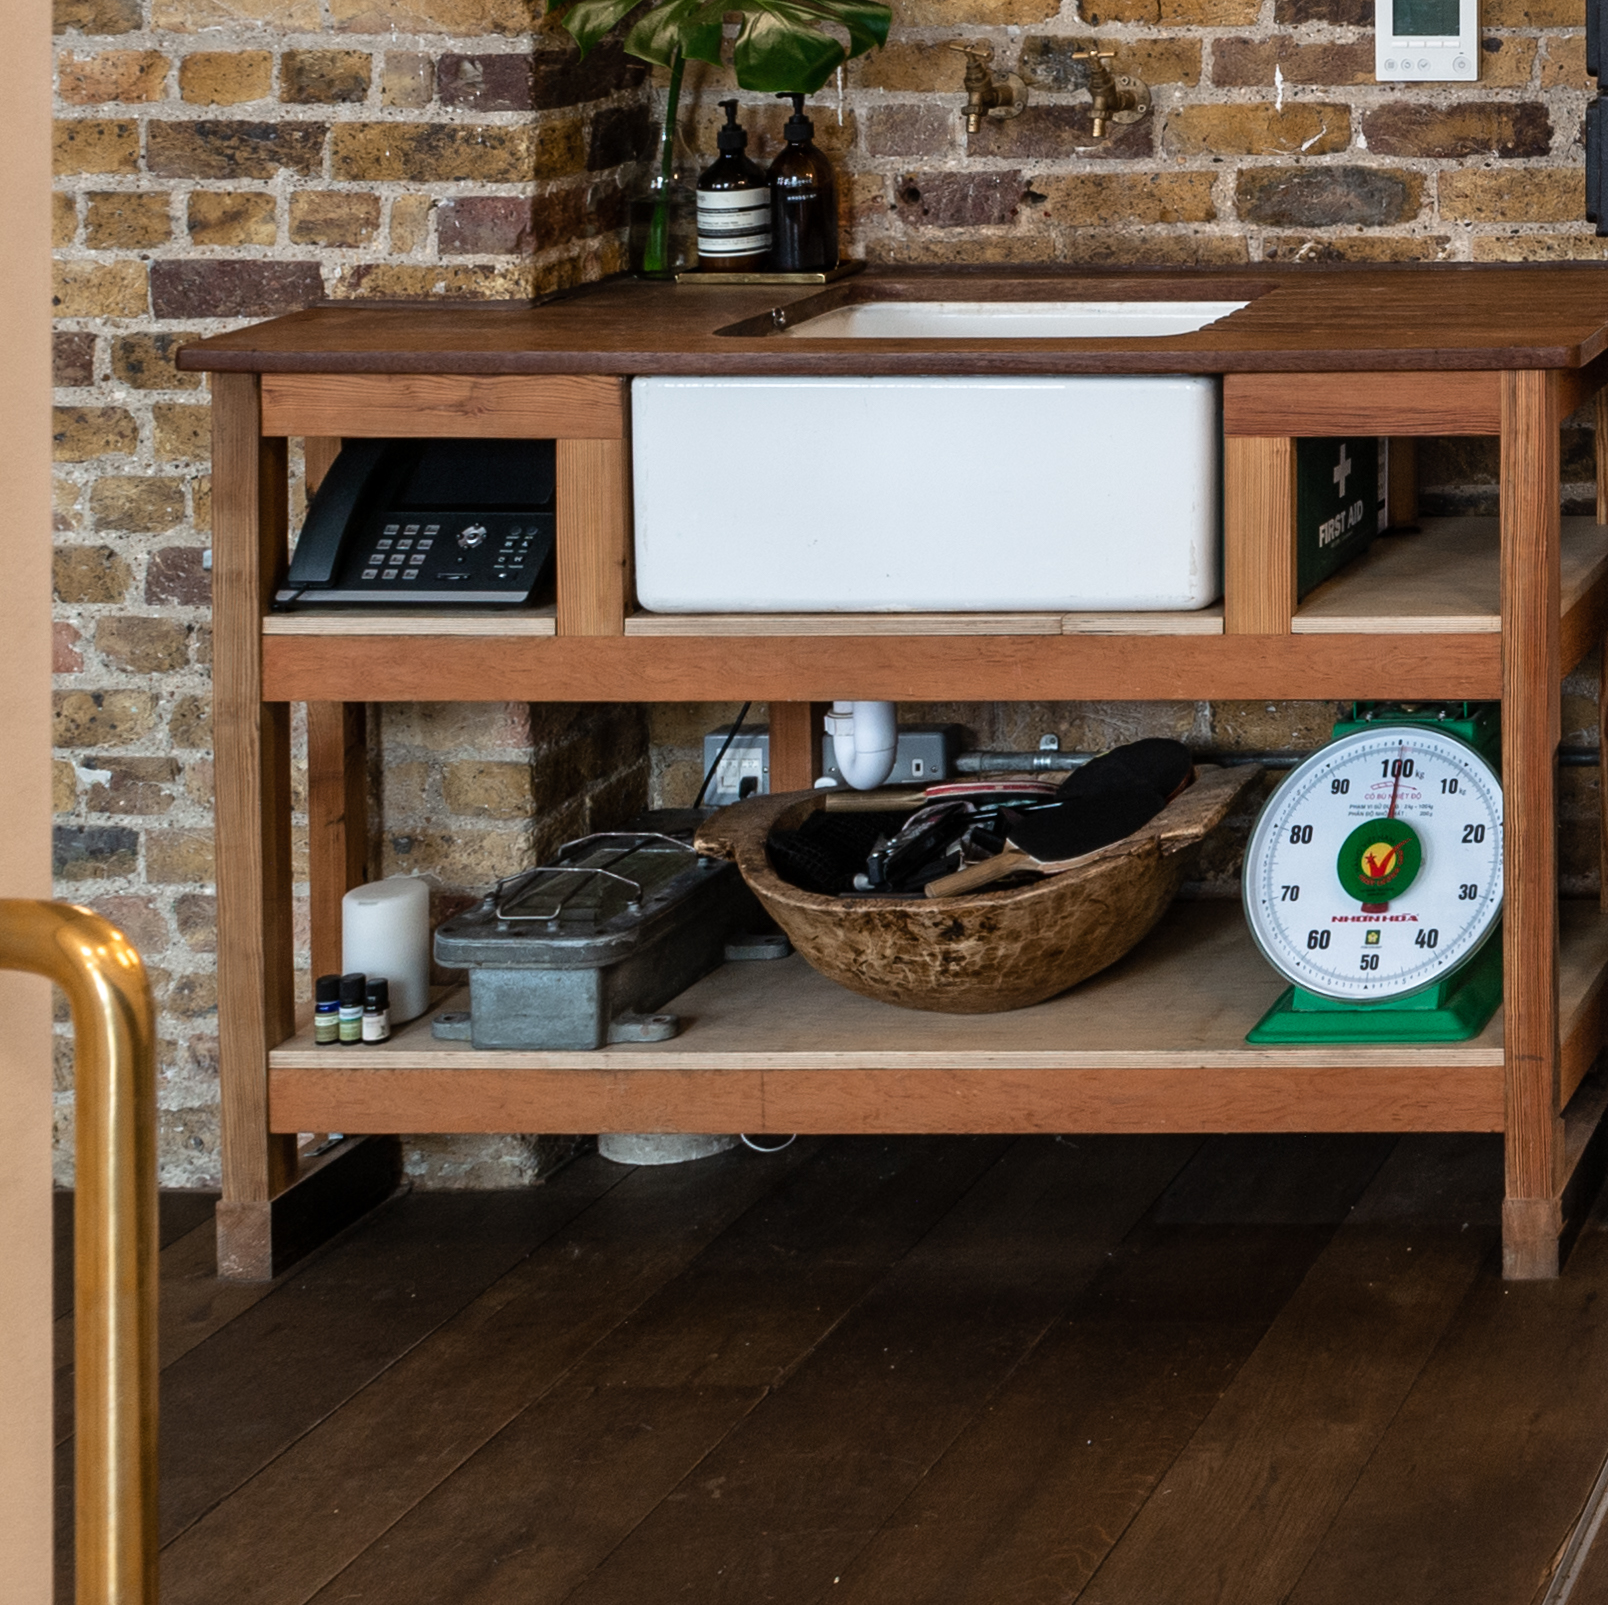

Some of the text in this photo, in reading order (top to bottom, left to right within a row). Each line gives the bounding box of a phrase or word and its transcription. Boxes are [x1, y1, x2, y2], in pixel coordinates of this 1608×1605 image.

[1319, 499, 1364, 548] FIRST AID
[1381, 758, 1414, 778] 100
[1330, 778, 1350, 795] 90
[1440, 778, 1459, 794] 10
[1289, 824, 1313, 845] 80
[1461, 824, 1485, 844] 20
[1281, 885, 1300, 902] 70
[1458, 883, 1478, 901] 30
[1306, 929, 1331, 950] 60
[1414, 928, 1439, 949] 40
[1359, 954, 1380, 971] 50
